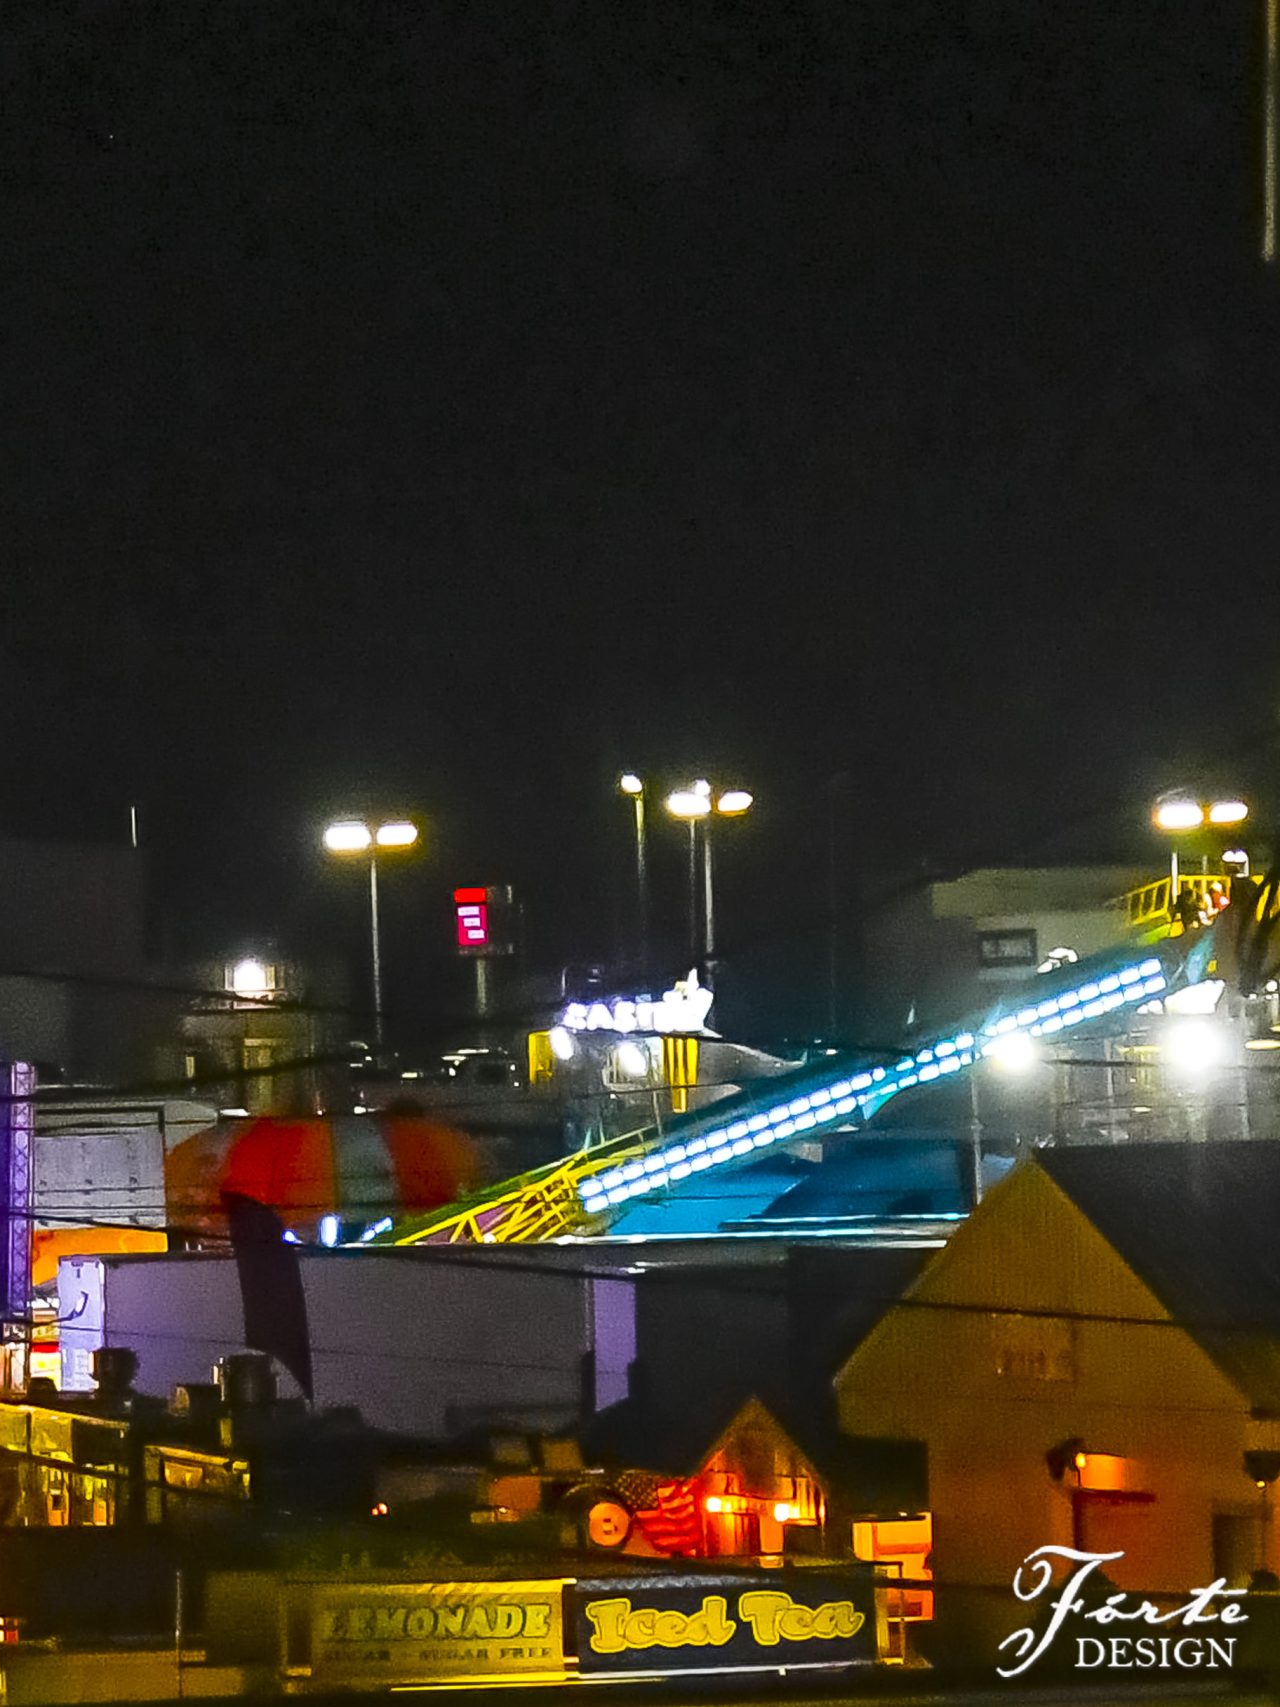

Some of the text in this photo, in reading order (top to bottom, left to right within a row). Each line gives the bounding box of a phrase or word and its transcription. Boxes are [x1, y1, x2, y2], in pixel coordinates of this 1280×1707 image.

[320, 1603, 551, 1640] LEMONADE
[586, 1591, 865, 1653] Iced Tea
